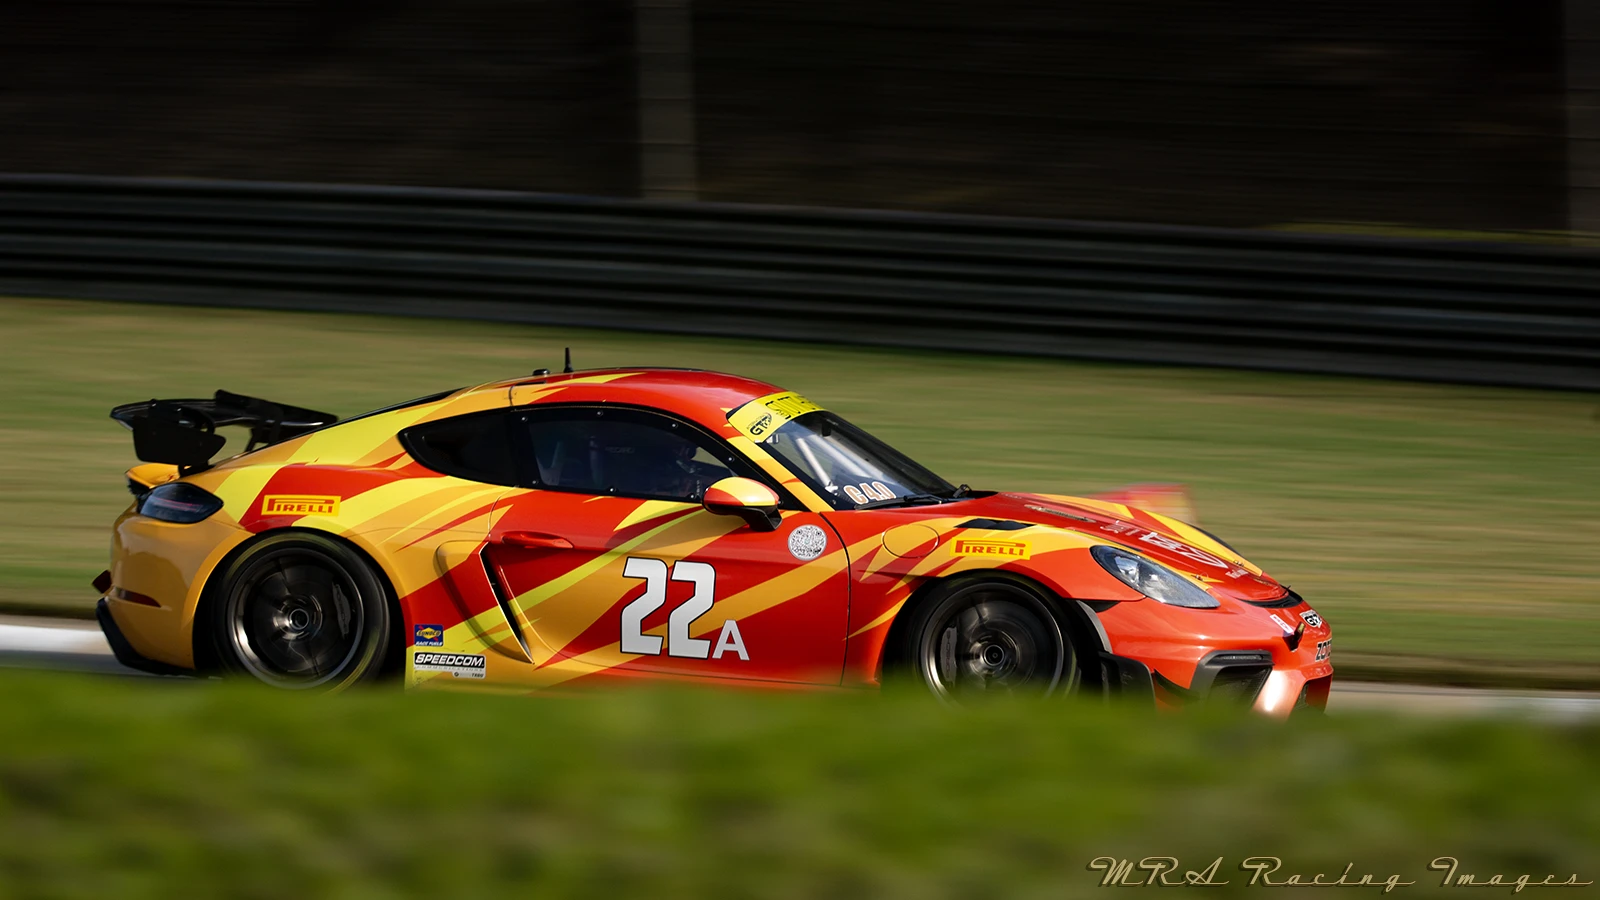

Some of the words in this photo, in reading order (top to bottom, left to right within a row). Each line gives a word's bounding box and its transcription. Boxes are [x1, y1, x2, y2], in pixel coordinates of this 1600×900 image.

[267, 498, 334, 513] PIRELLI
[955, 540, 1026, 556] PIRELLI
[415, 654, 484, 667] SPEEDCOM
